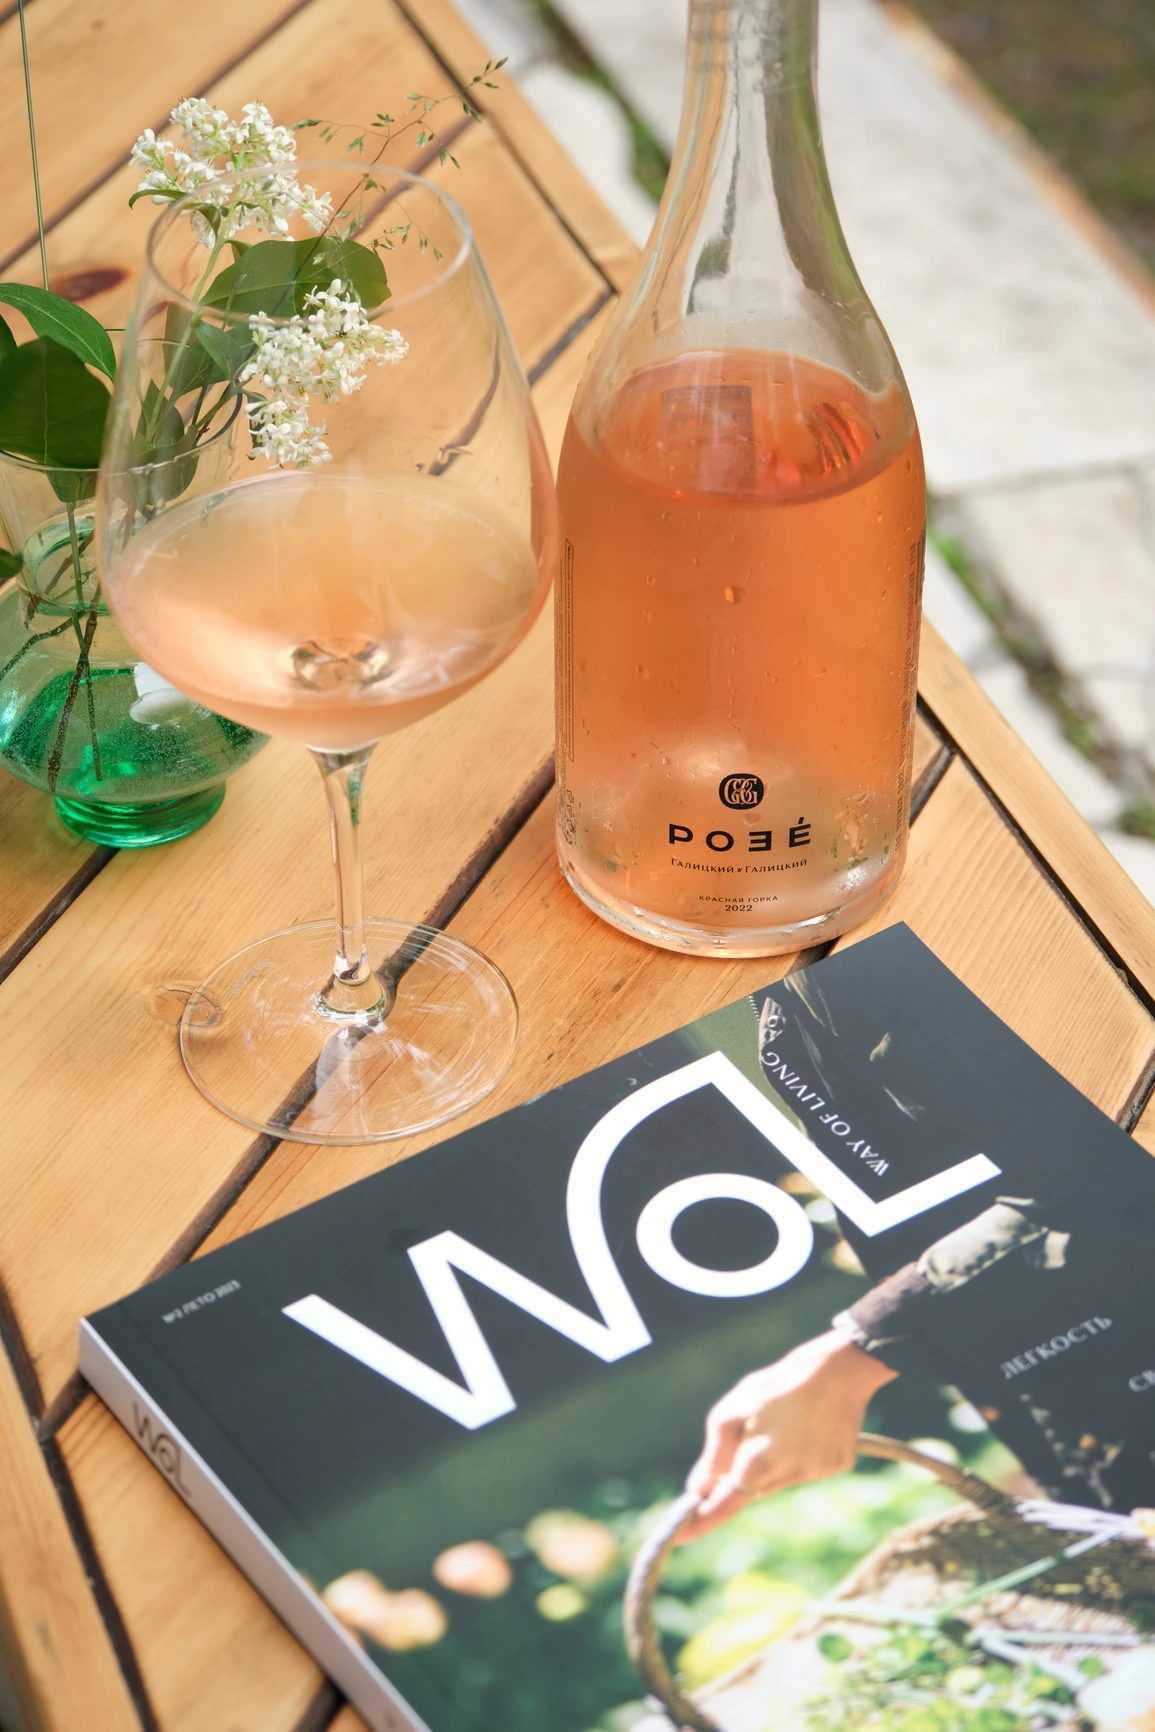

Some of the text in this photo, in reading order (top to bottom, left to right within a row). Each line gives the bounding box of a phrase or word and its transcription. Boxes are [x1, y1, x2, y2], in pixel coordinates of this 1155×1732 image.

[698, 895, 778, 903] КРАСНАЯ ГОРКА
[724, 904, 753, 912] 2022
[761, 1052, 889, 1177] WAY OF LIVING
[999, 1315, 1113, 1380] ЛЕГКОСТЬ
